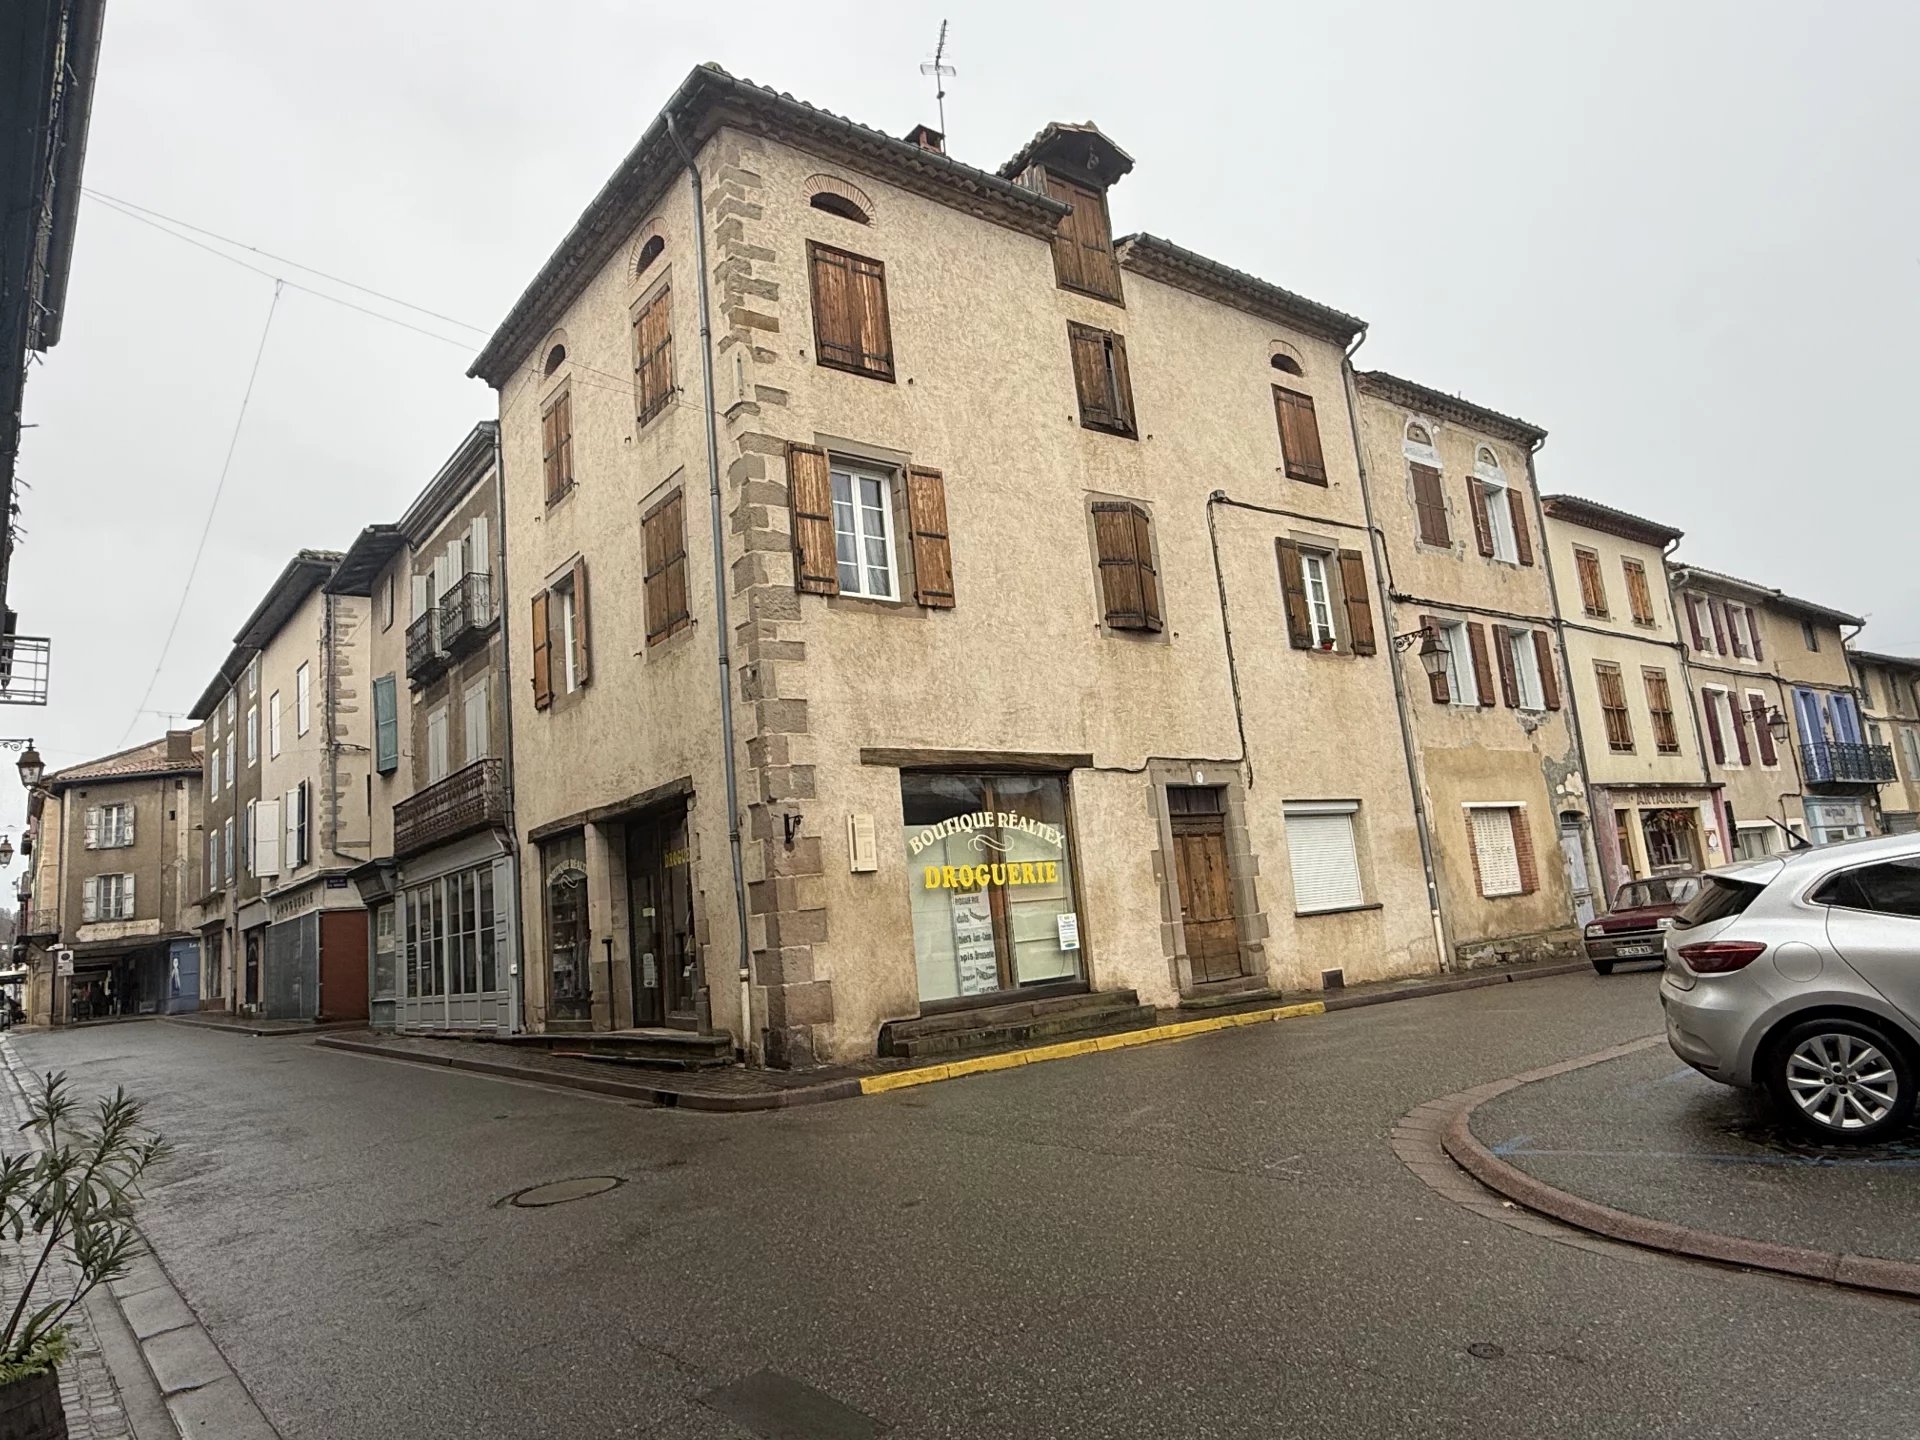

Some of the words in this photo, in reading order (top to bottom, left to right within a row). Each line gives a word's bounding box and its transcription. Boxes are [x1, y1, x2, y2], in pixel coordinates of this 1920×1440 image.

[1637, 790, 1688, 805] ANTARGAZ
[909, 811, 994, 854] BOUTIQUE
[997, 809, 1065, 849] RÉALTEX
[664, 849, 690, 868] DROGU
[924, 862, 1059, 888] DROGUERIE
